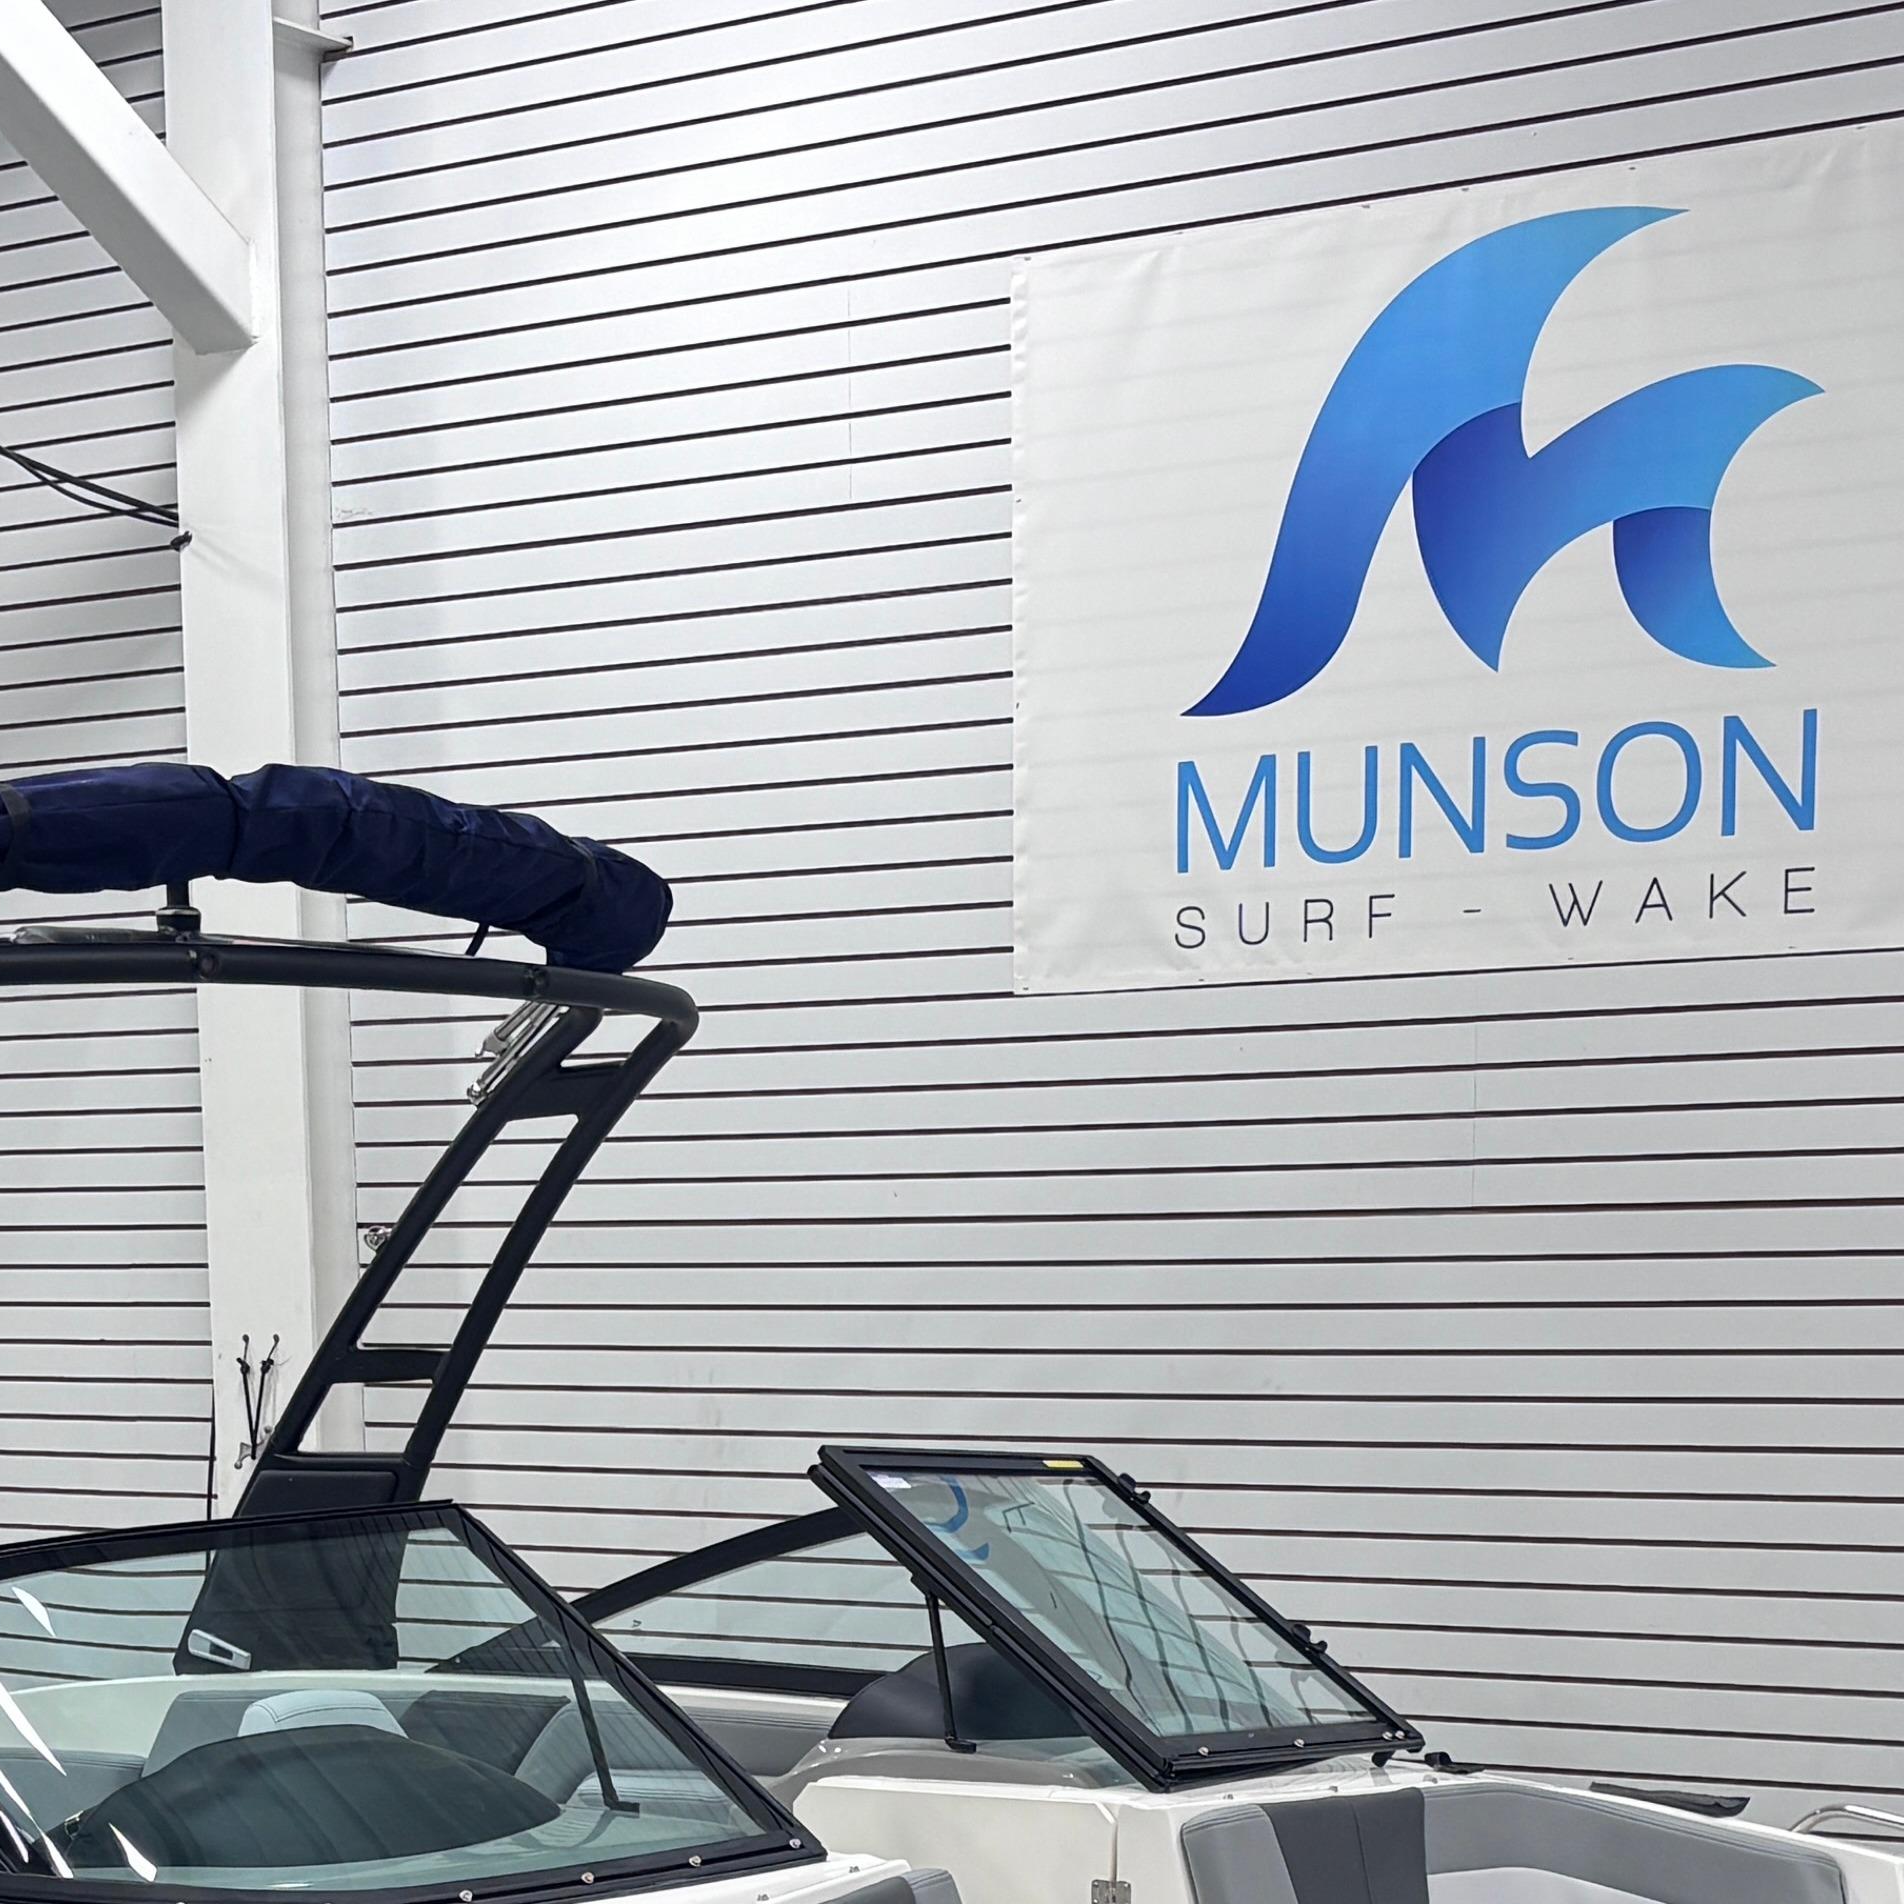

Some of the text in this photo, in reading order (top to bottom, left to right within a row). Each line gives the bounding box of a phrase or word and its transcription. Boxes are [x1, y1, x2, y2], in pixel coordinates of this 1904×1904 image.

[1175, 708, 1819, 875] MUNSON
[1173, 892, 1398, 950] SURF
[1547, 865, 1818, 930] WAKE
